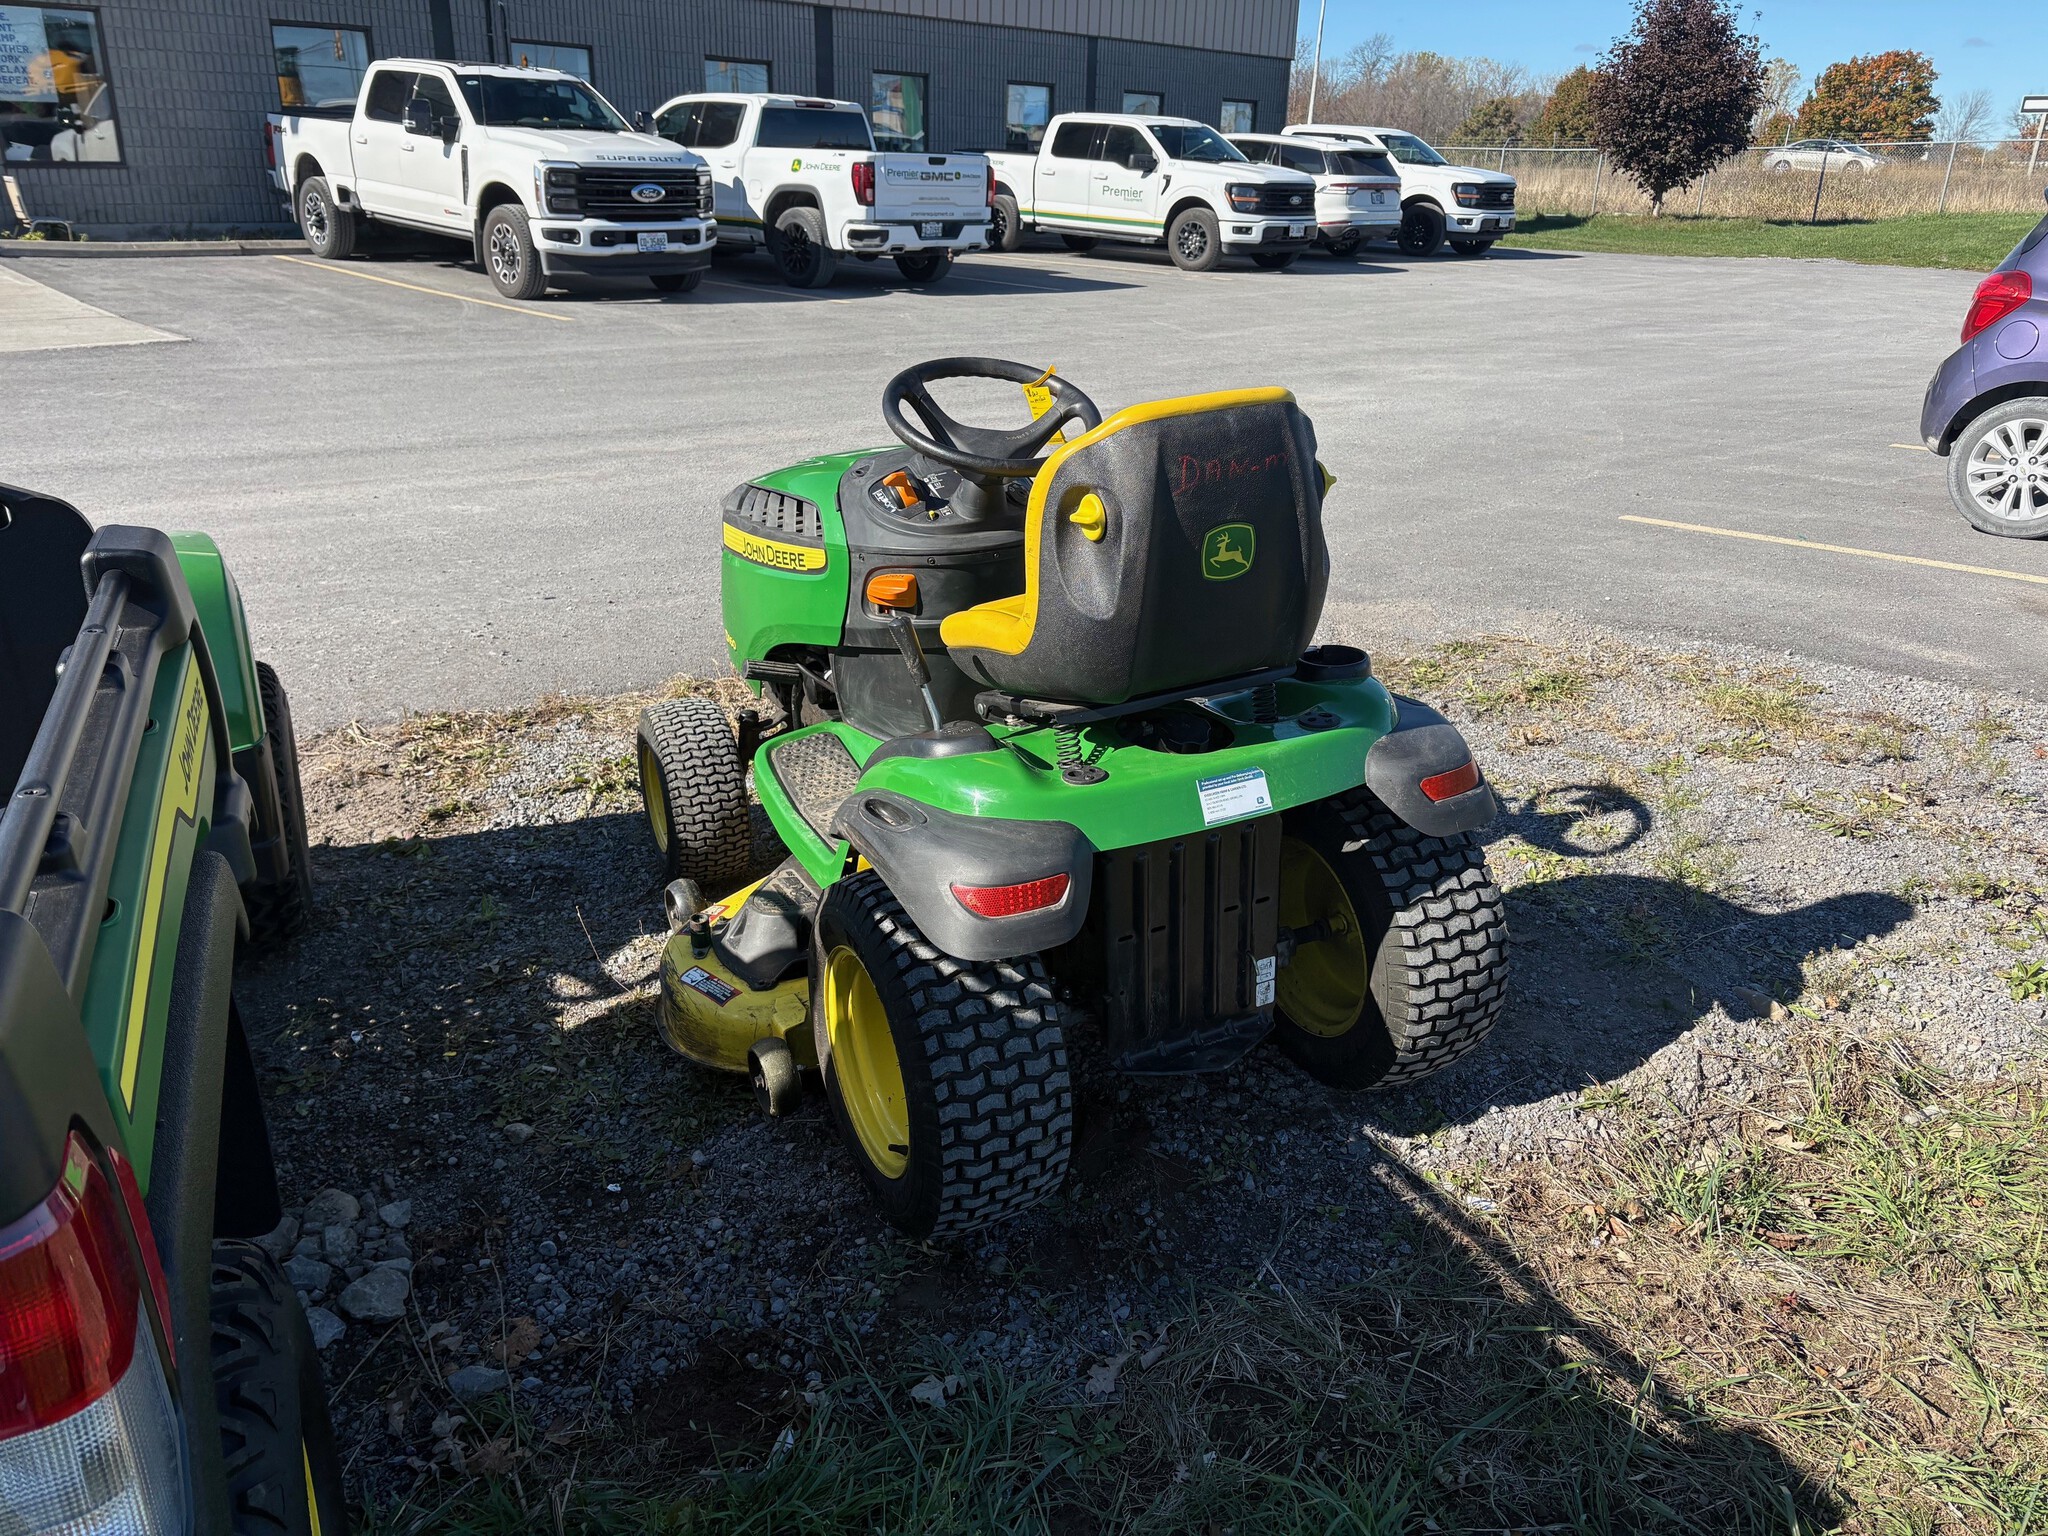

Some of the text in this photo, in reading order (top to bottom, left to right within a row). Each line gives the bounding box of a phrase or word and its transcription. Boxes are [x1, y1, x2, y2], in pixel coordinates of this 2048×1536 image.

[596, 154, 646, 162] SUPER
[803, 162, 841, 171] JOHN DEERE
[886, 168, 919, 178] Premier
[920, 171, 954, 181] GMC
[641, 188, 658, 198] Ford
[1102, 185, 1144, 199] Premier
[742, 537, 807, 569] JOHN DEERE
[178, 677, 204, 797] JOHN DEERE
